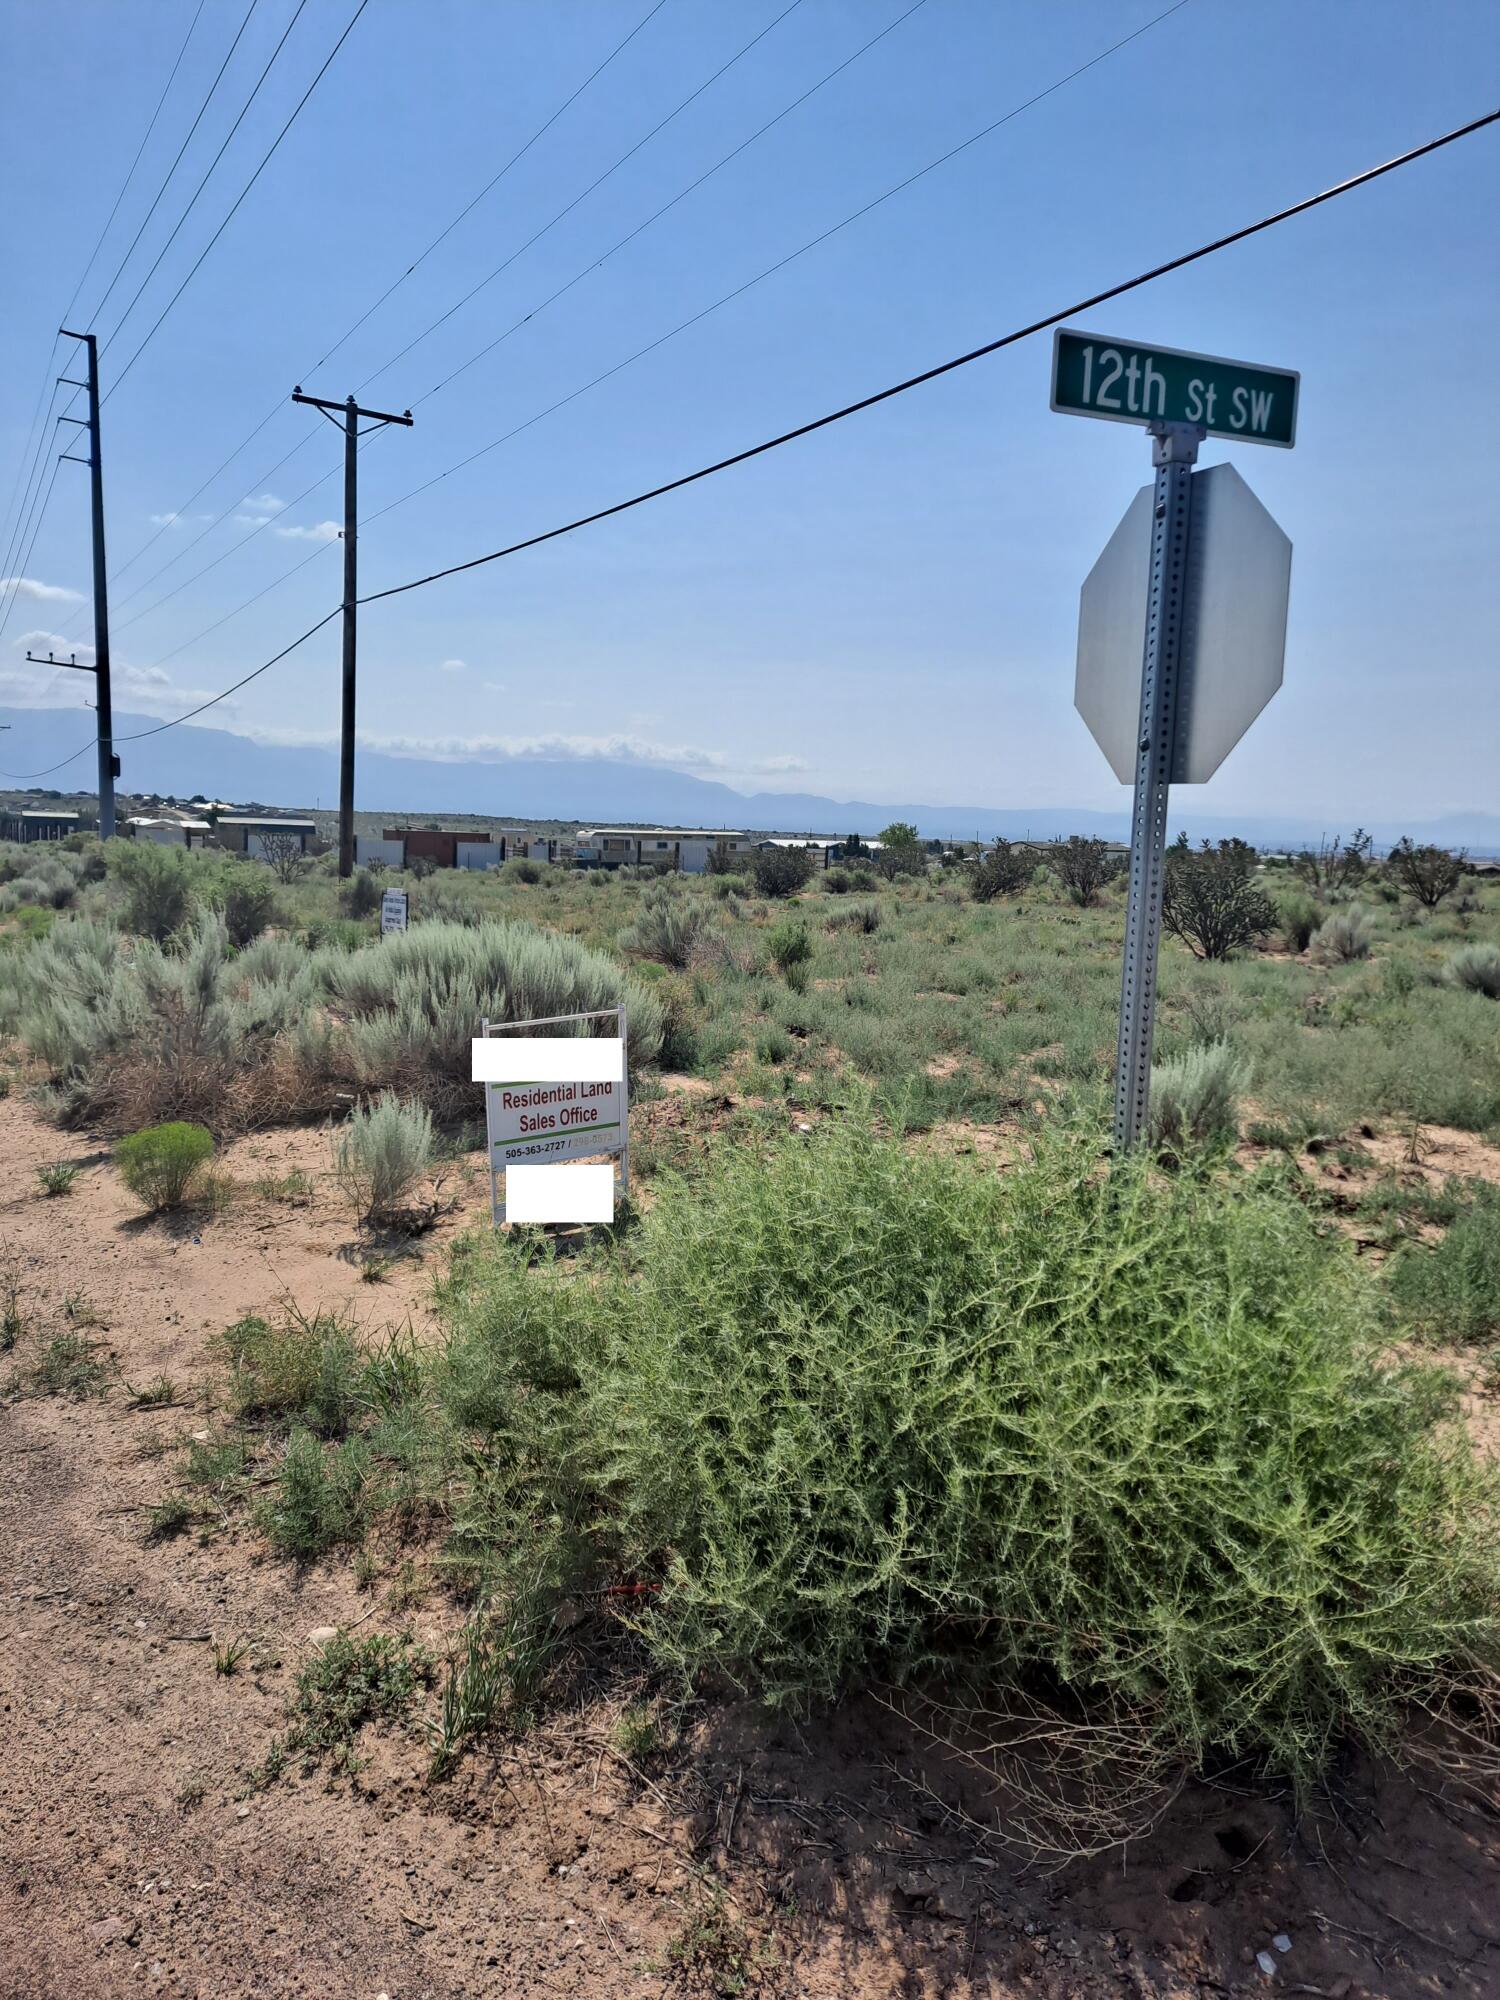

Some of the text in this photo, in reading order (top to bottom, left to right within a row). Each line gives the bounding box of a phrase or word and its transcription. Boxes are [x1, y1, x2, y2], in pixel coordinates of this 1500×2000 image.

[1082, 345, 1273, 433] 12th St SW
[503, 1081, 613, 1110] Residential Land
[519, 1106, 598, 1132] Sales Office
[505, 1140, 566, 1159] 505-363-2727
